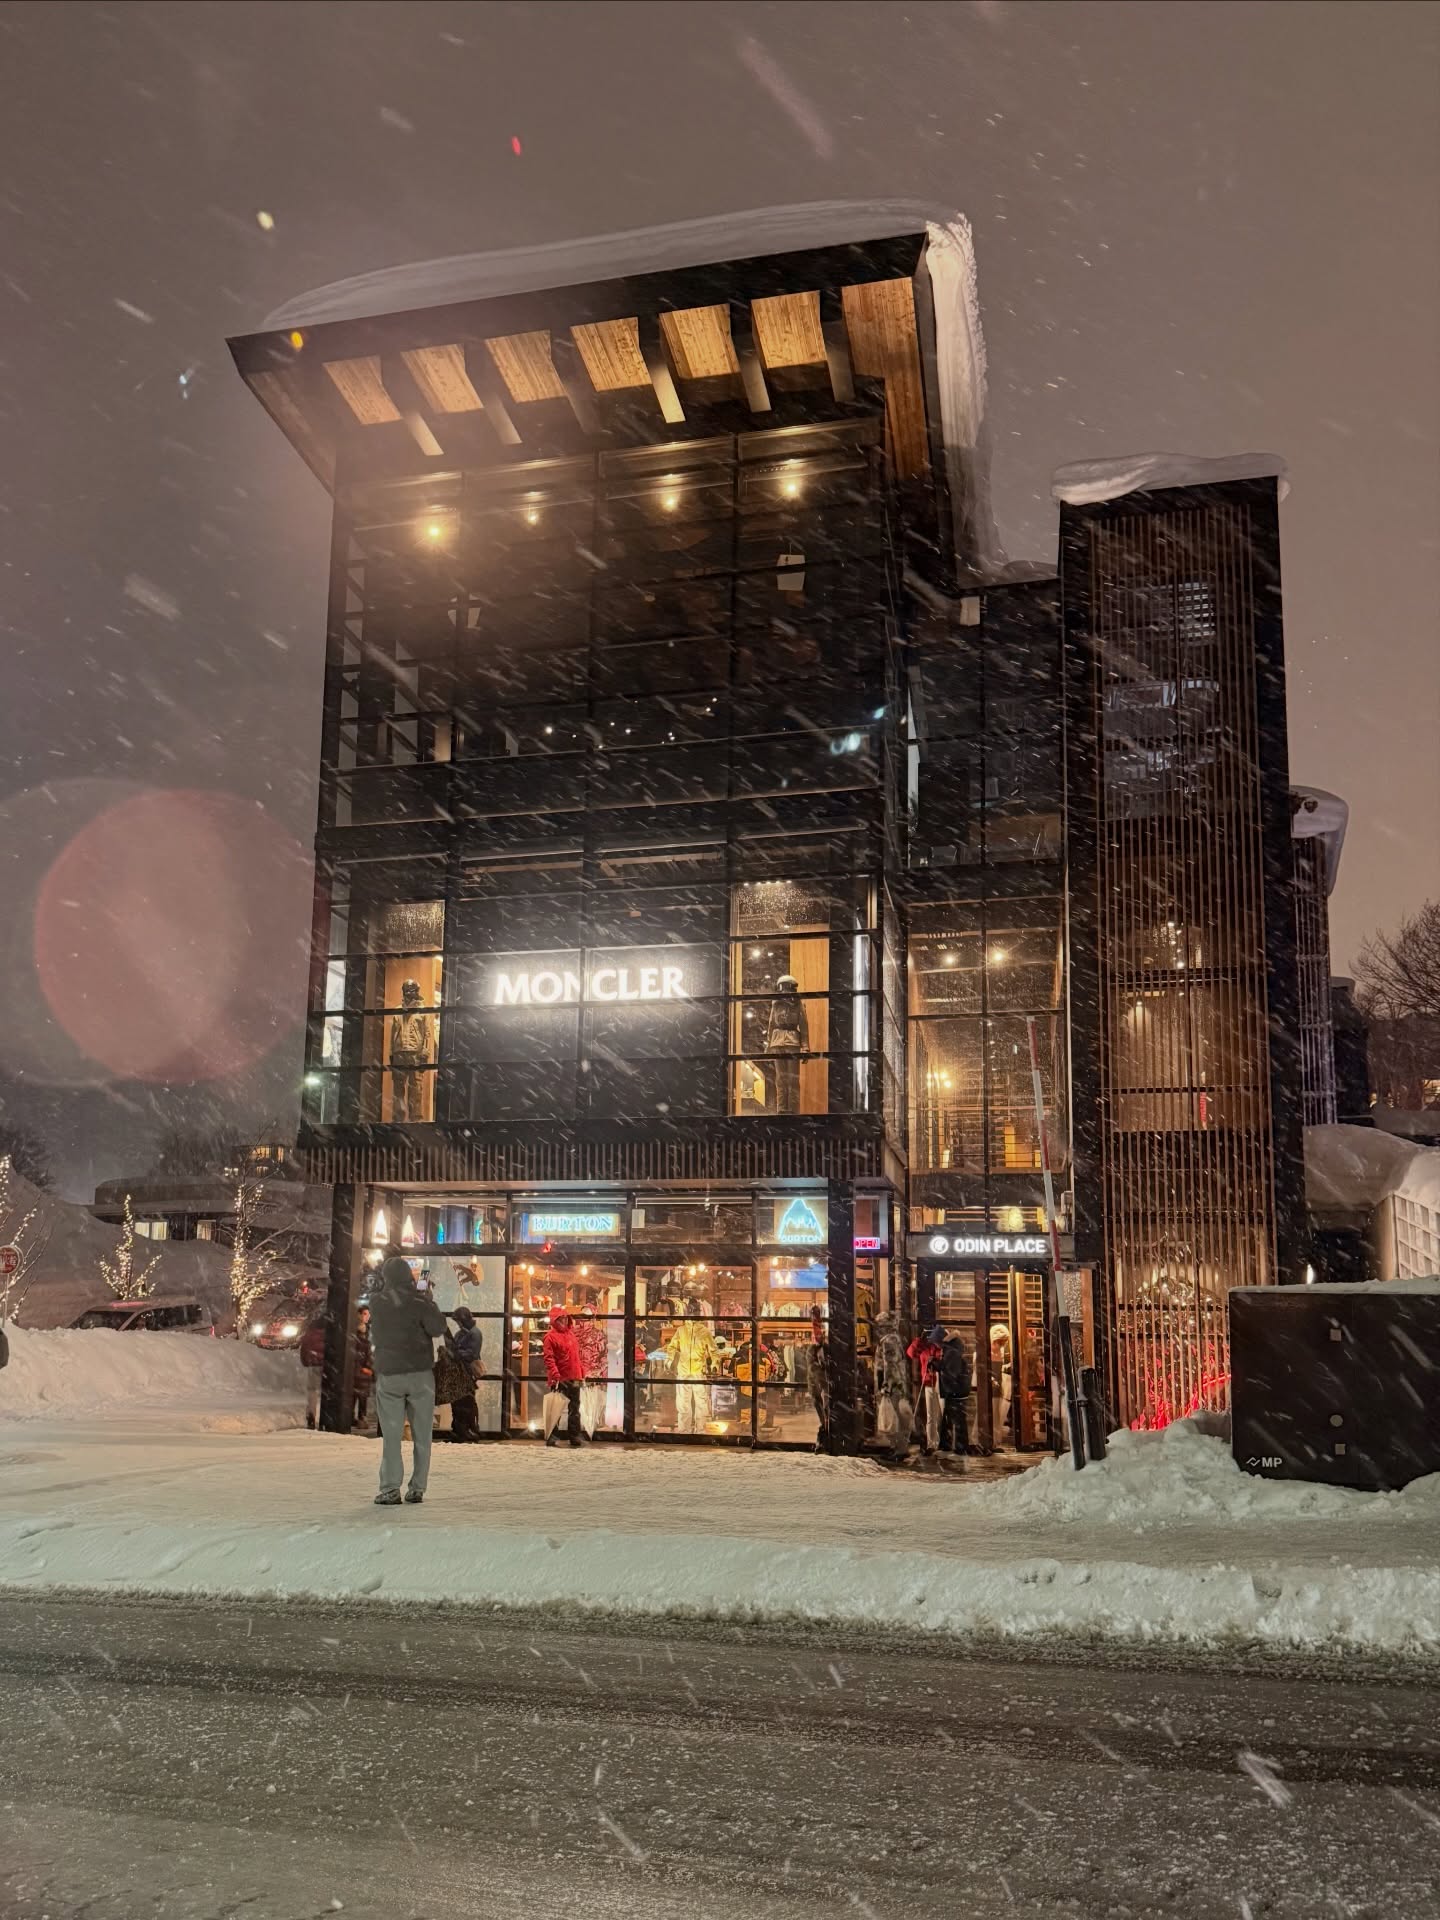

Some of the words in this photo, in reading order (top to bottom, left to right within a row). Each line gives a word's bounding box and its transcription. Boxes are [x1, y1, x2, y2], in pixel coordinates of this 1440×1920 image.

[494, 966, 690, 1004] MONCLER
[532, 1215, 614, 1232] BURTON
[854, 1239, 878, 1249] OPEN
[954, 1238, 991, 1253] ODIN
[993, 1238, 1047, 1253] PLACE
[1261, 1456, 1283, 1468] MP
